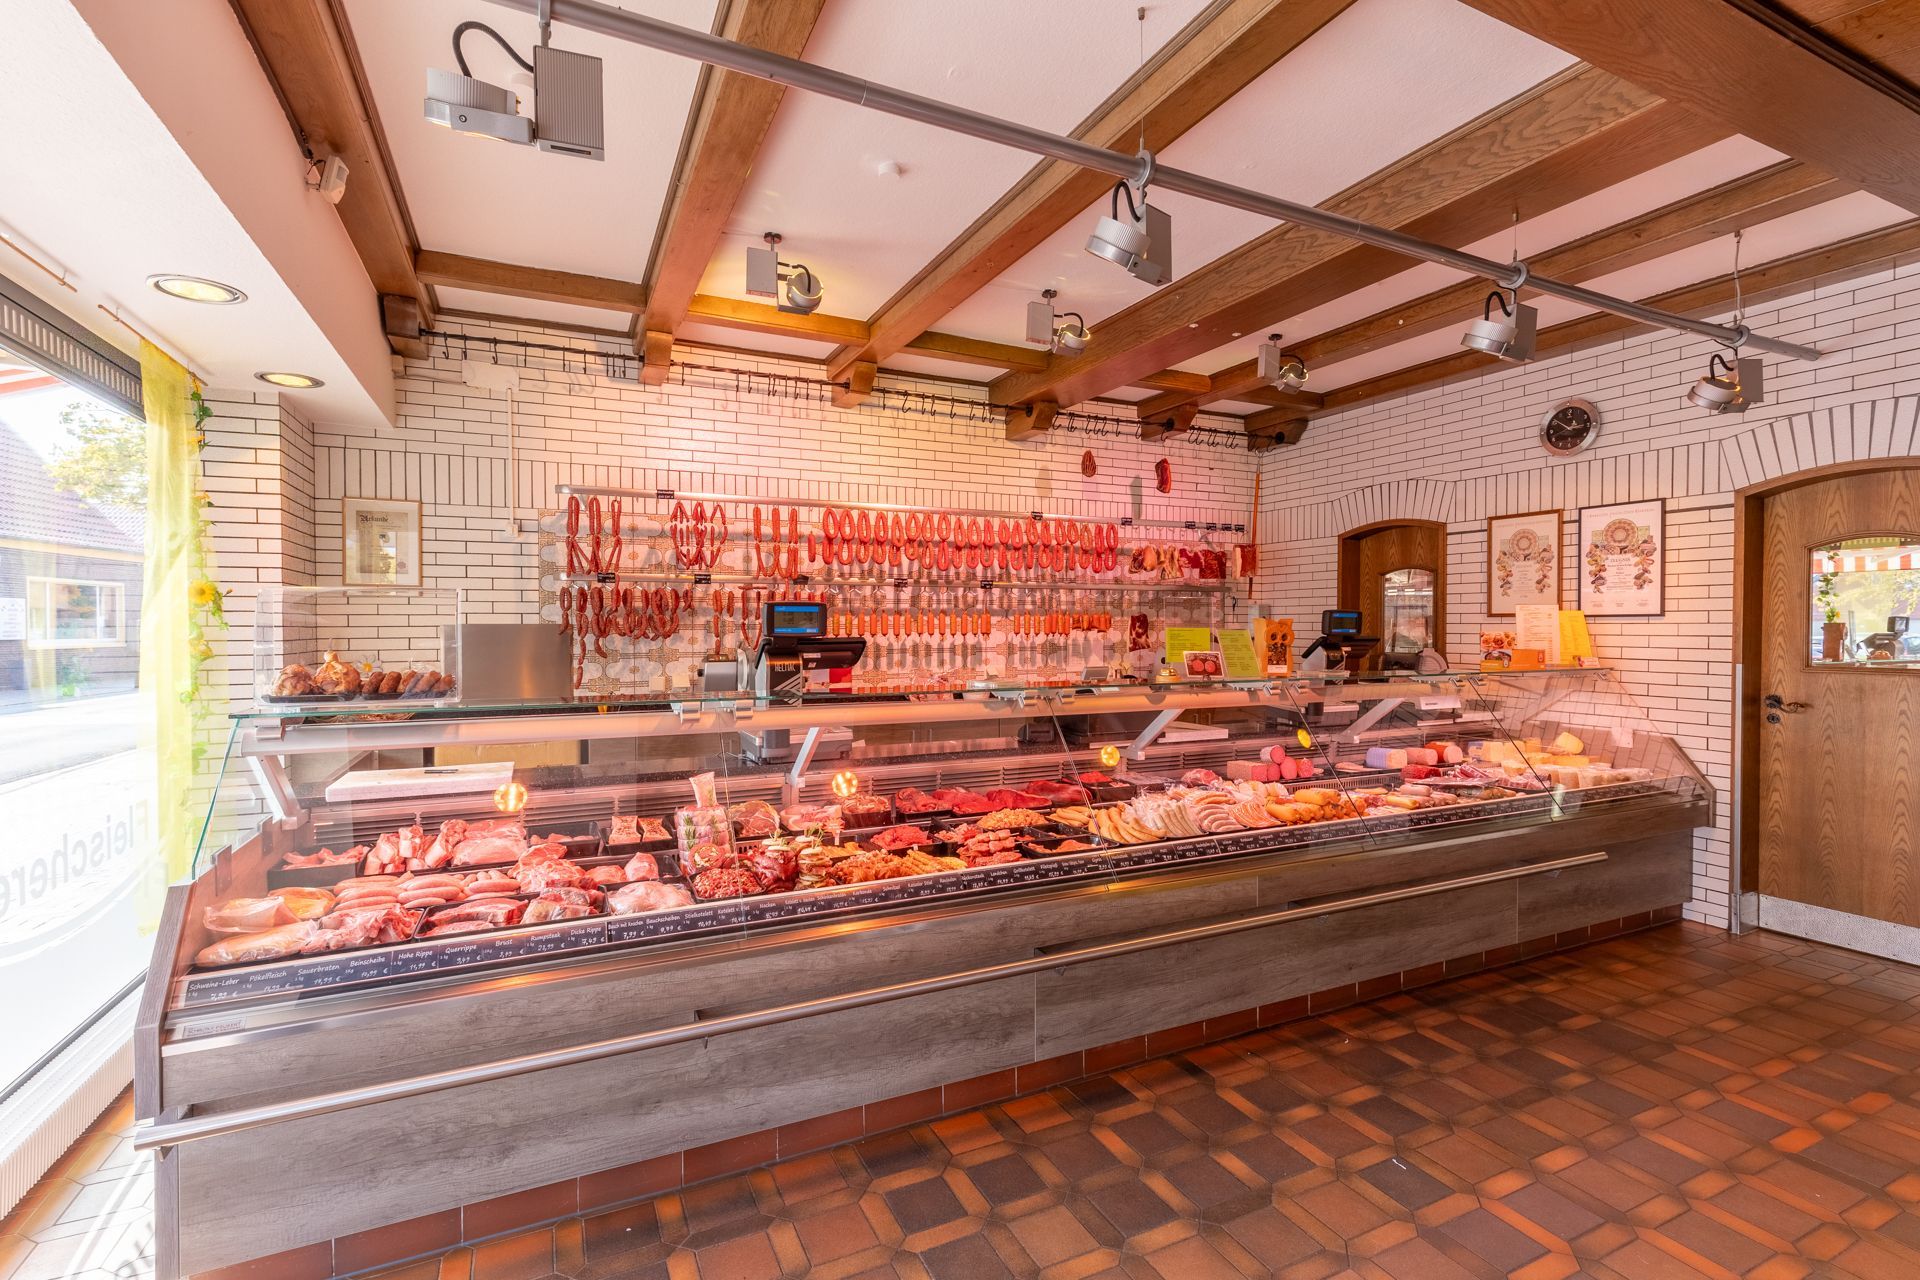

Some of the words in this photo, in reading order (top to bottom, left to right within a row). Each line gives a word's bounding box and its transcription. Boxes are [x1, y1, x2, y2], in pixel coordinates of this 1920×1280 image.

[360, 514, 388, 524] Urkunde
[587, 927, 602, 935] Rippe
[530, 933, 561, 942] Rumpsteak
[495, 939, 513, 947] Brust
[445, 944, 477, 954] Querrippe
[416, 950, 433, 960] Rippe
[350, 956, 386, 968] Beinscheibe
[298, 964, 340, 976] Sauerbraten
[189, 978, 240, 991] Schweine-Leber
